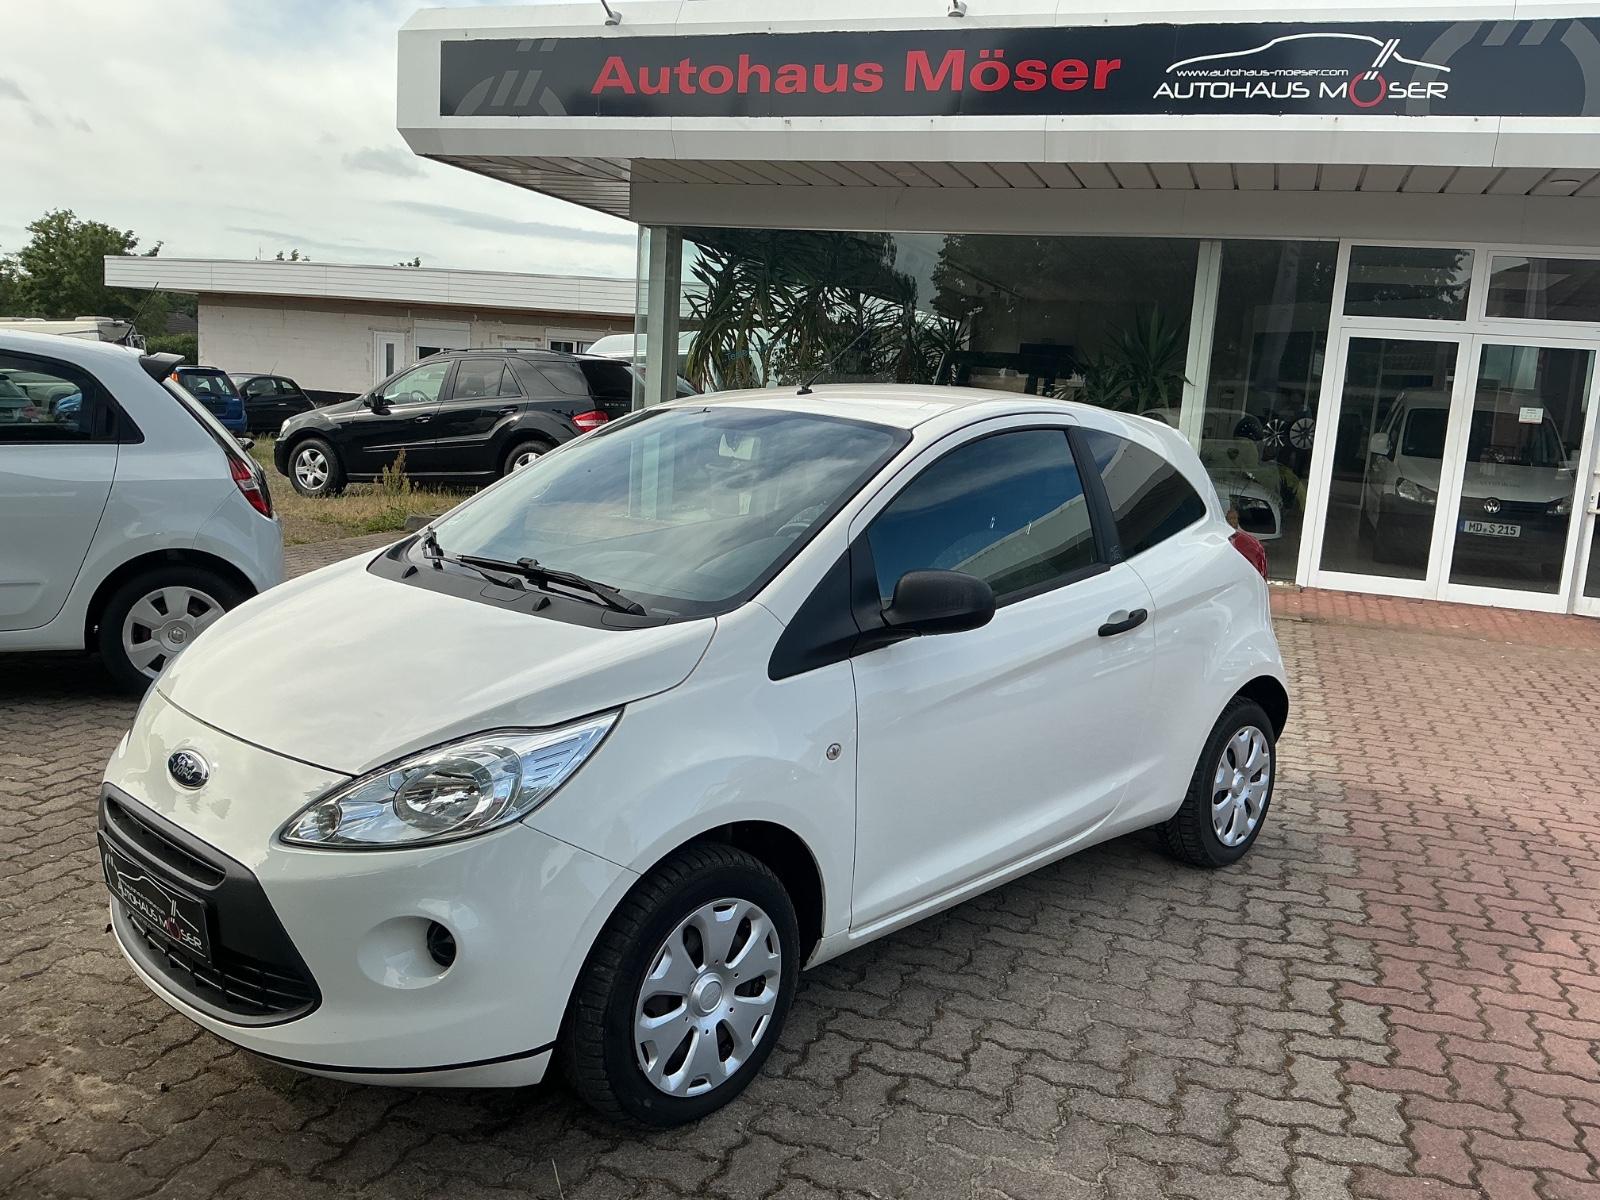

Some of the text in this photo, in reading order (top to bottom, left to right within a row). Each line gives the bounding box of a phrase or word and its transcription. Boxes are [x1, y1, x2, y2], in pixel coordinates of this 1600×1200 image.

[591, 49, 1122, 95] Autohaus Möser
[1176, 69, 1349, 77] www.autohaus-moeser.com
[1152, 71, 1449, 108] AUTOHAUS MÖSER
[1468, 521, 1483, 532] MD
[1497, 525, 1517, 536] 215
